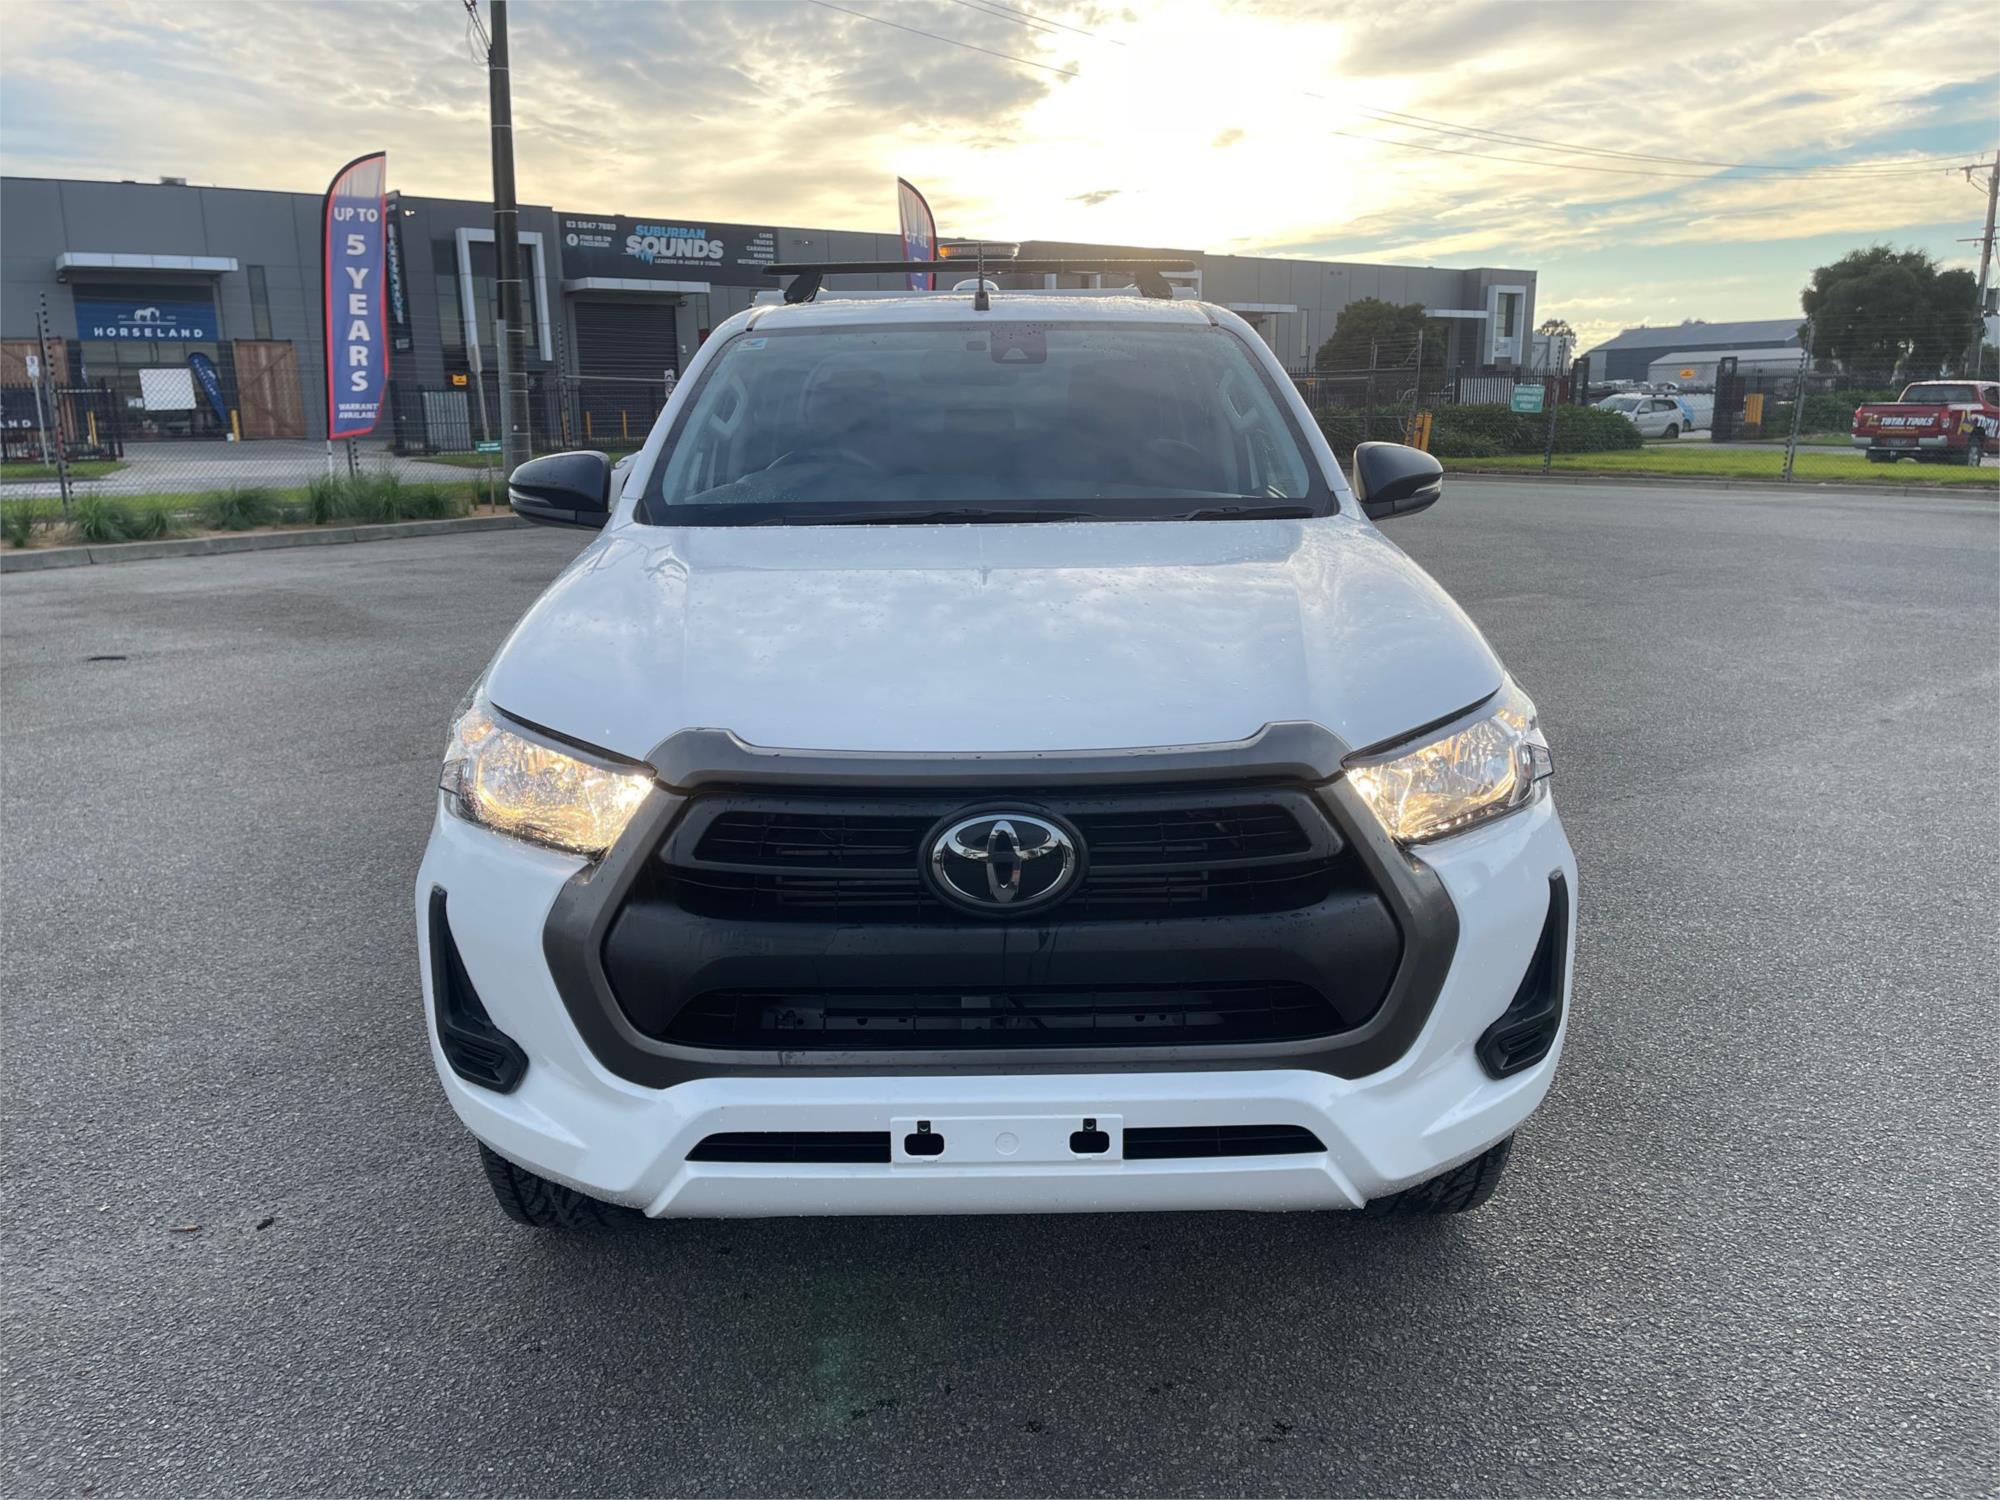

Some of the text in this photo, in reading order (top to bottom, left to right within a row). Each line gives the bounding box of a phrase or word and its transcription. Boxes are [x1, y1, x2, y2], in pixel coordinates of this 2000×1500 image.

[333, 206, 355, 221] UP
[356, 207, 379, 223] TO
[635, 224, 706, 239] SUBURBAN
[625, 235, 724, 260] SOUNDS
[345, 233, 371, 392] 5 YEARS
[93, 327, 204, 338] HORSELAND
[338, 403, 379, 411] WARRANT
[338, 411, 376, 419] AVAILABL
[1881, 416, 1935, 426] TOTAL TOOLS
